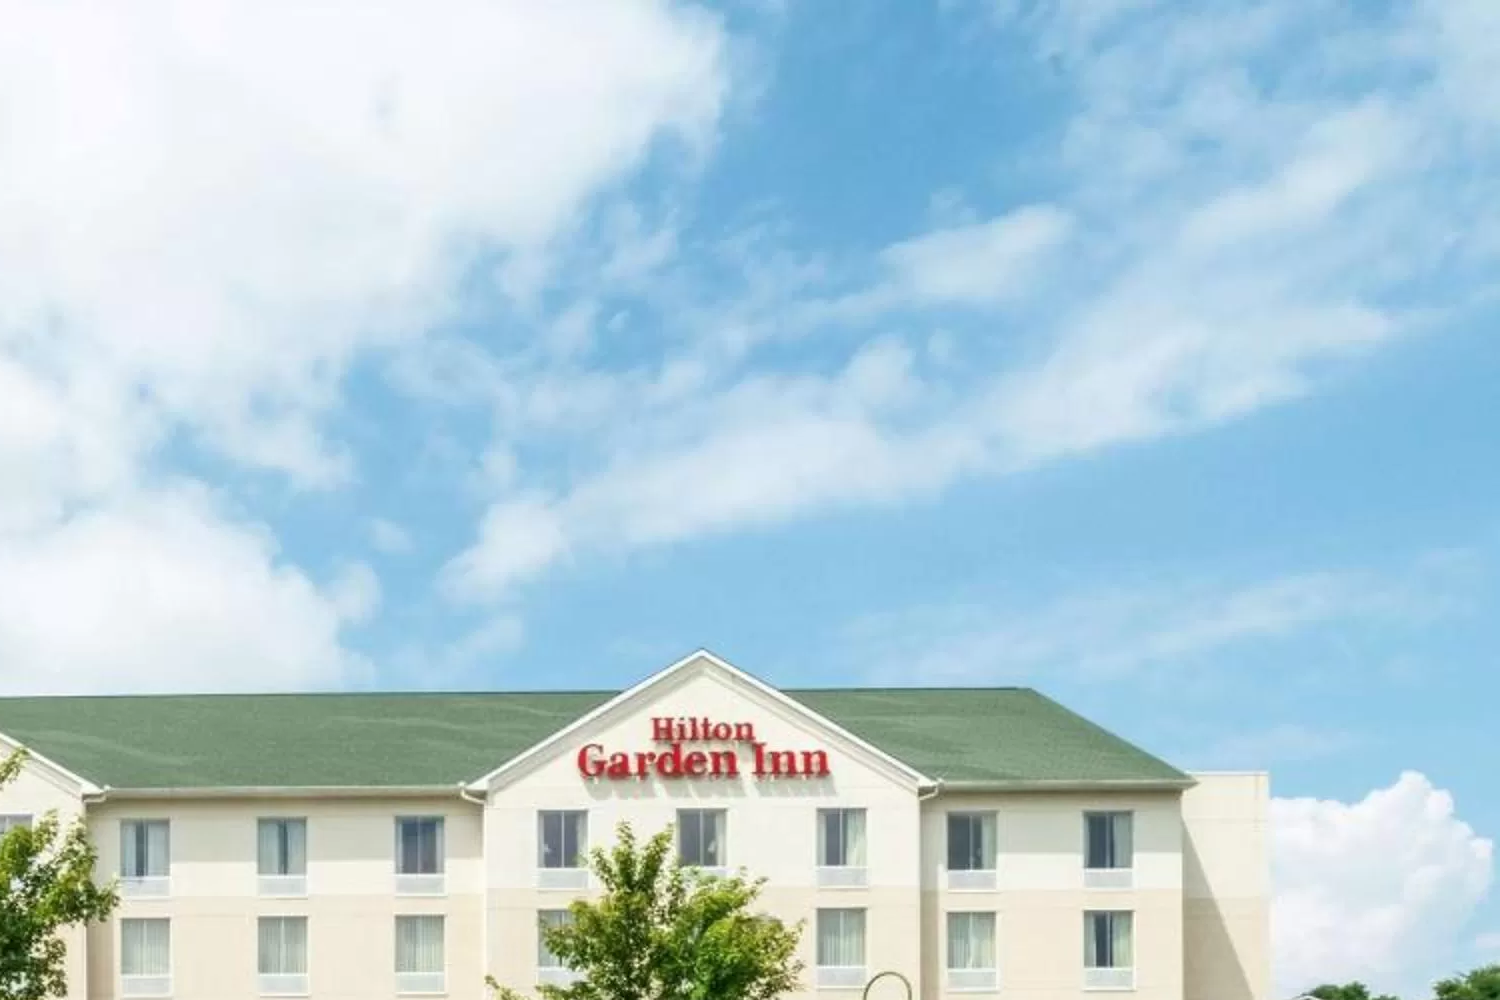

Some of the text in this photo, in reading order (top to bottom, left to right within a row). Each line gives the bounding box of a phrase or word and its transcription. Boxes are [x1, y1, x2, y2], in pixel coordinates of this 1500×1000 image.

[651, 717, 755, 741] Hilton
[578, 743, 830, 778] Garden Inn
